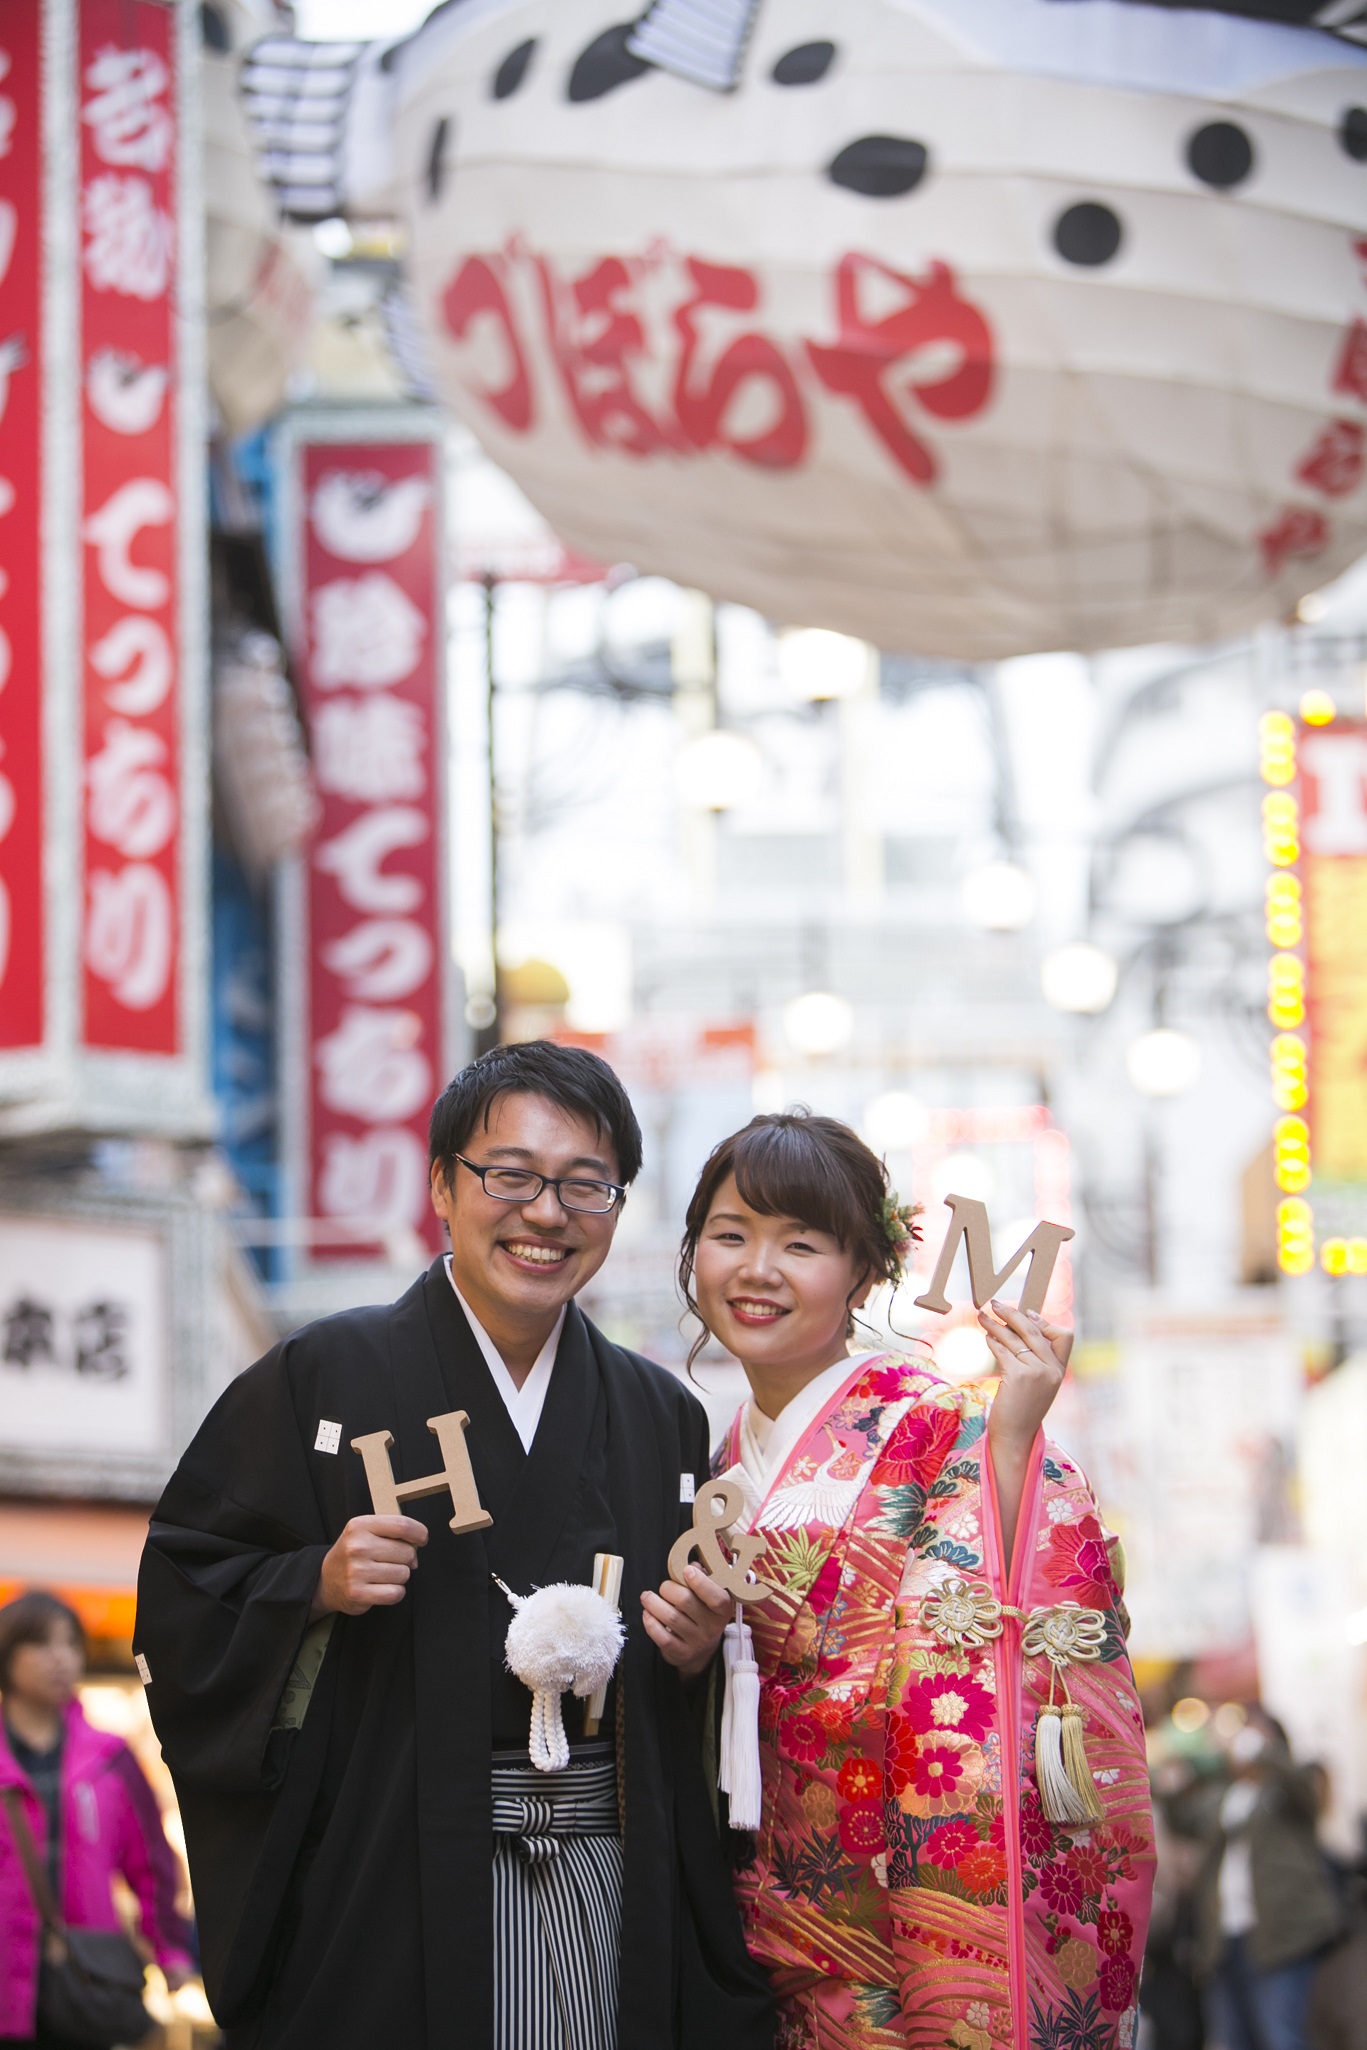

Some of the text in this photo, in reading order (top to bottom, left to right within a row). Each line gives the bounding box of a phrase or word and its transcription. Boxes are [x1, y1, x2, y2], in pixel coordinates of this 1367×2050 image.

[913, 1193, 1075, 1316] M
[350, 1410, 494, 1534] H
[667, 1479, 774, 1601] &
